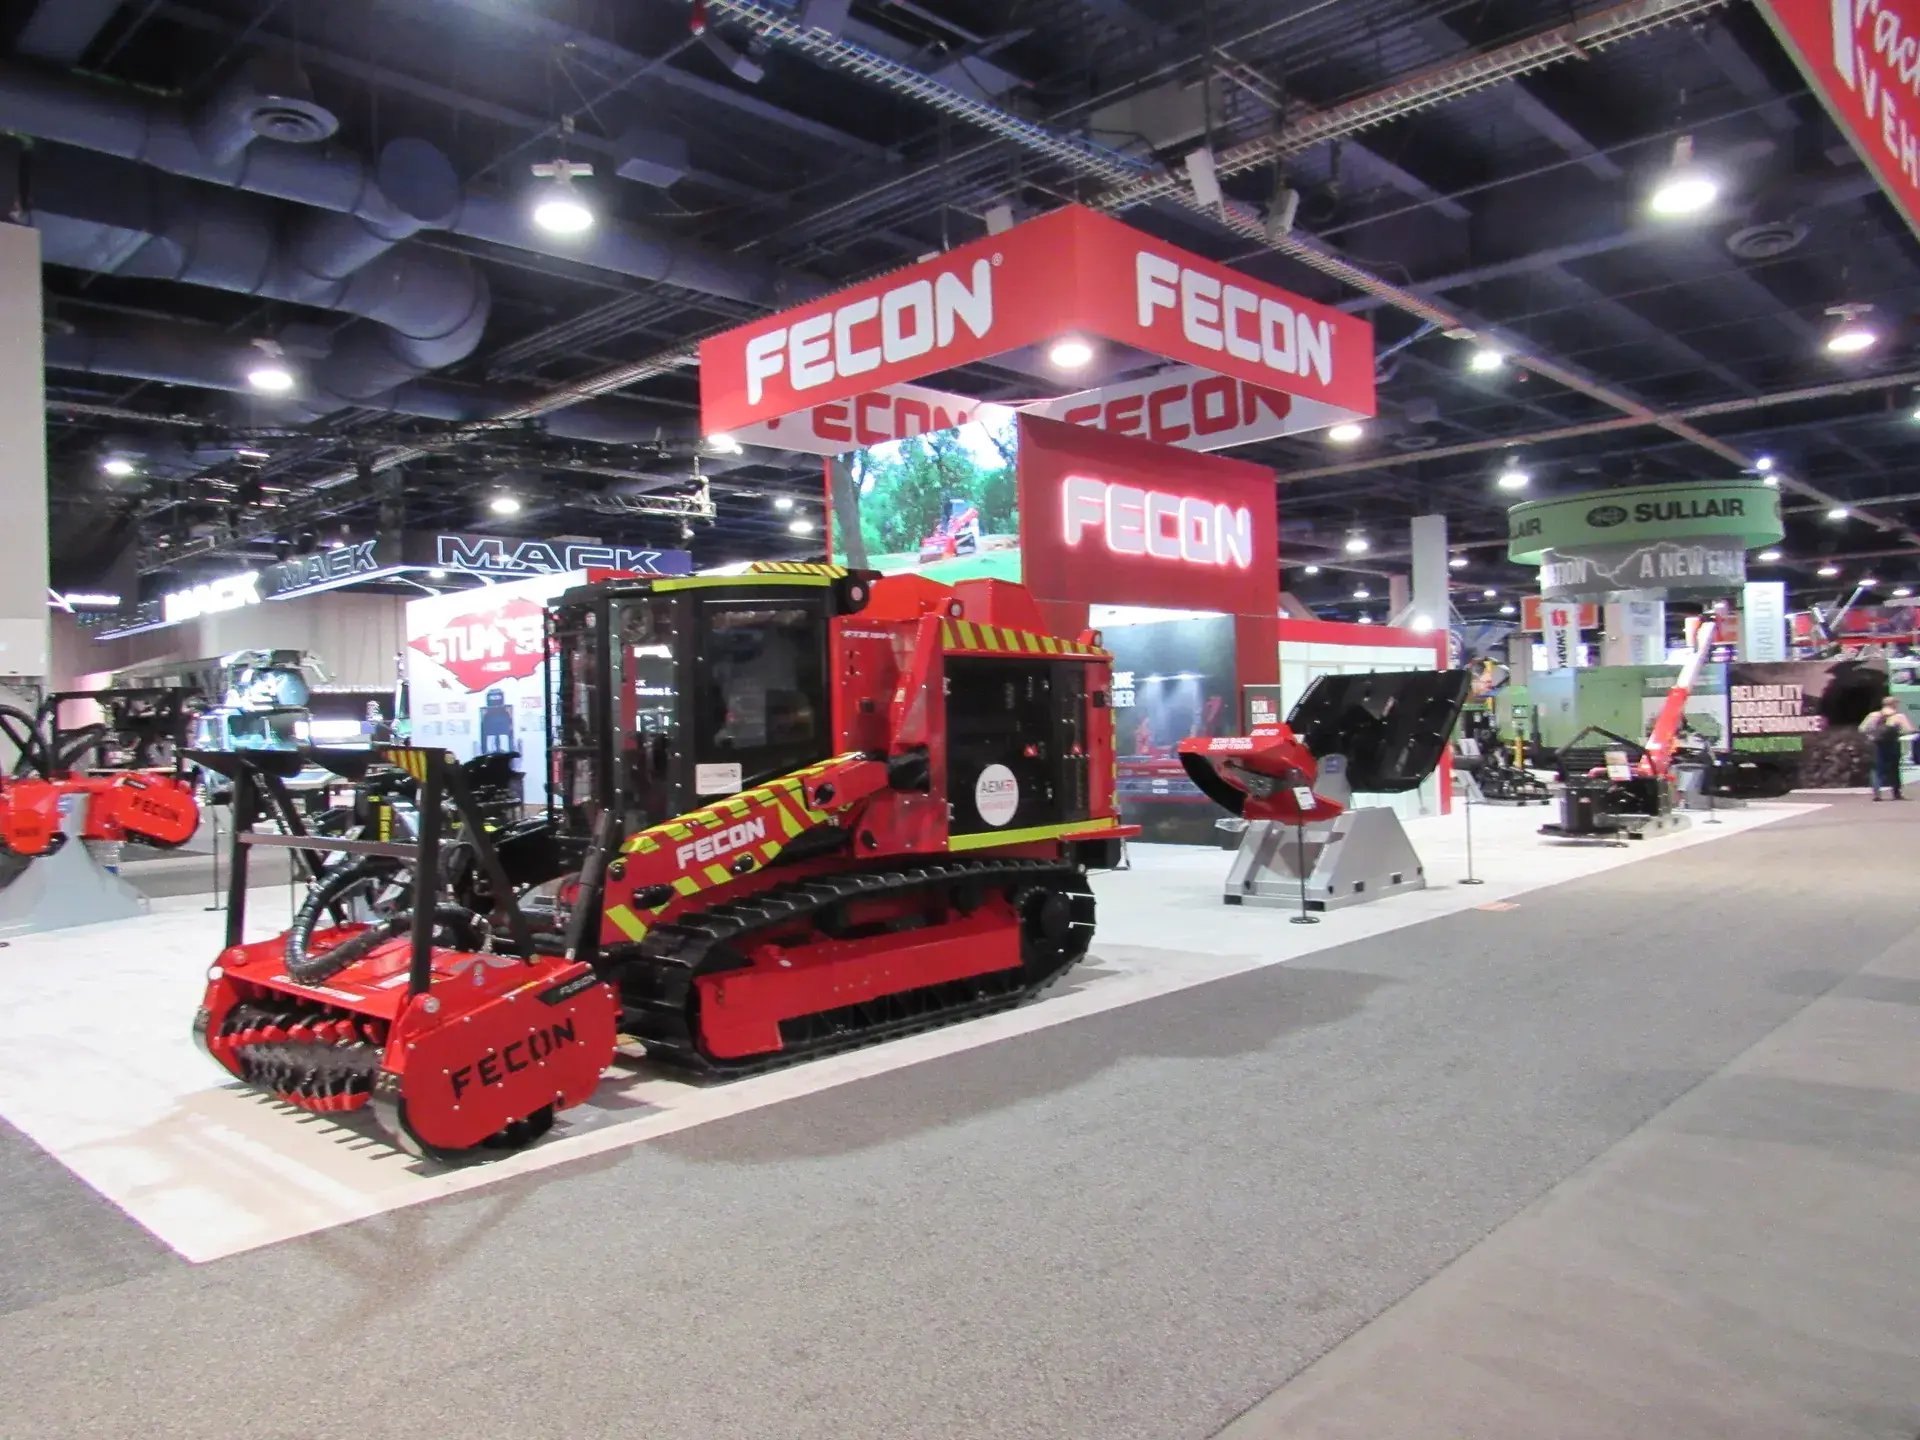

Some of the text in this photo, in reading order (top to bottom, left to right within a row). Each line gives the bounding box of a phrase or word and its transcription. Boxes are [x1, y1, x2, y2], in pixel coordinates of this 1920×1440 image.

[745, 258, 994, 405] FECON
[1136, 251, 1332, 386] FECON
[1062, 475, 1253, 569] FECON
[1634, 498, 1745, 523] SULLAIR
[437, 535, 662, 575] MACK
[1639, 553, 1654, 579] A
[676, 816, 766, 870] FECON
[451, 1017, 576, 1101] FECON
